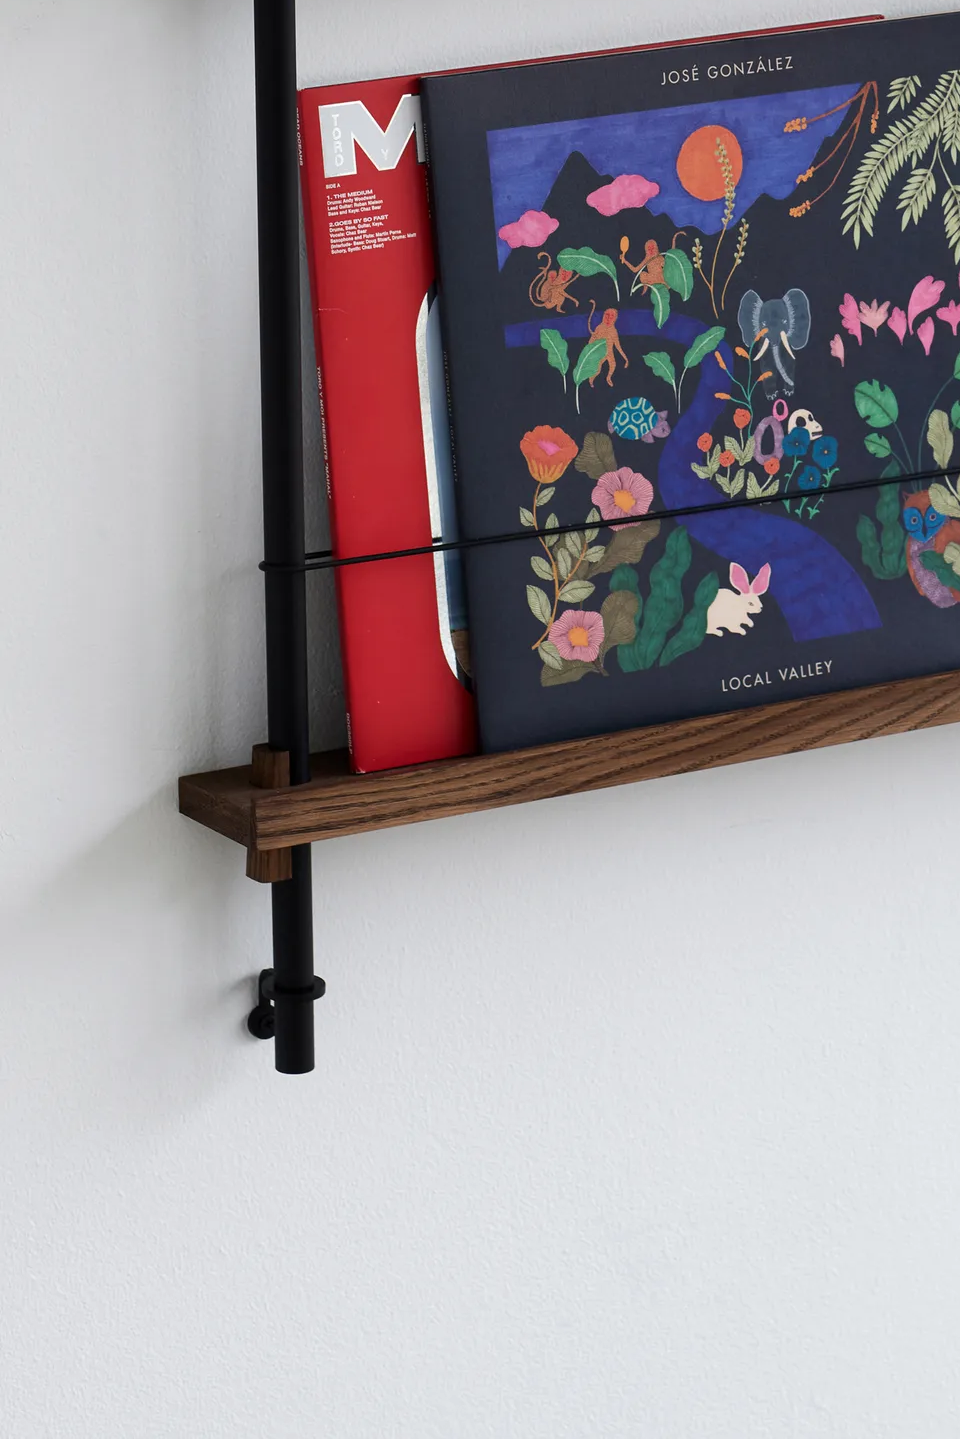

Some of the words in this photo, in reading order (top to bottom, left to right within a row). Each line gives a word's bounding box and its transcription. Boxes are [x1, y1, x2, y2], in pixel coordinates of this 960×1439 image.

[661, 65, 699, 85] JOSÉ
[707, 56, 793, 79] GONZÁLEZ
[332, 113, 344, 167] TORO
[381, 148, 388, 160] Y
[347, 189, 373, 197] MEDIUM
[721, 671, 772, 692] LOCAL
[778, 660, 833, 681] VALLEY
